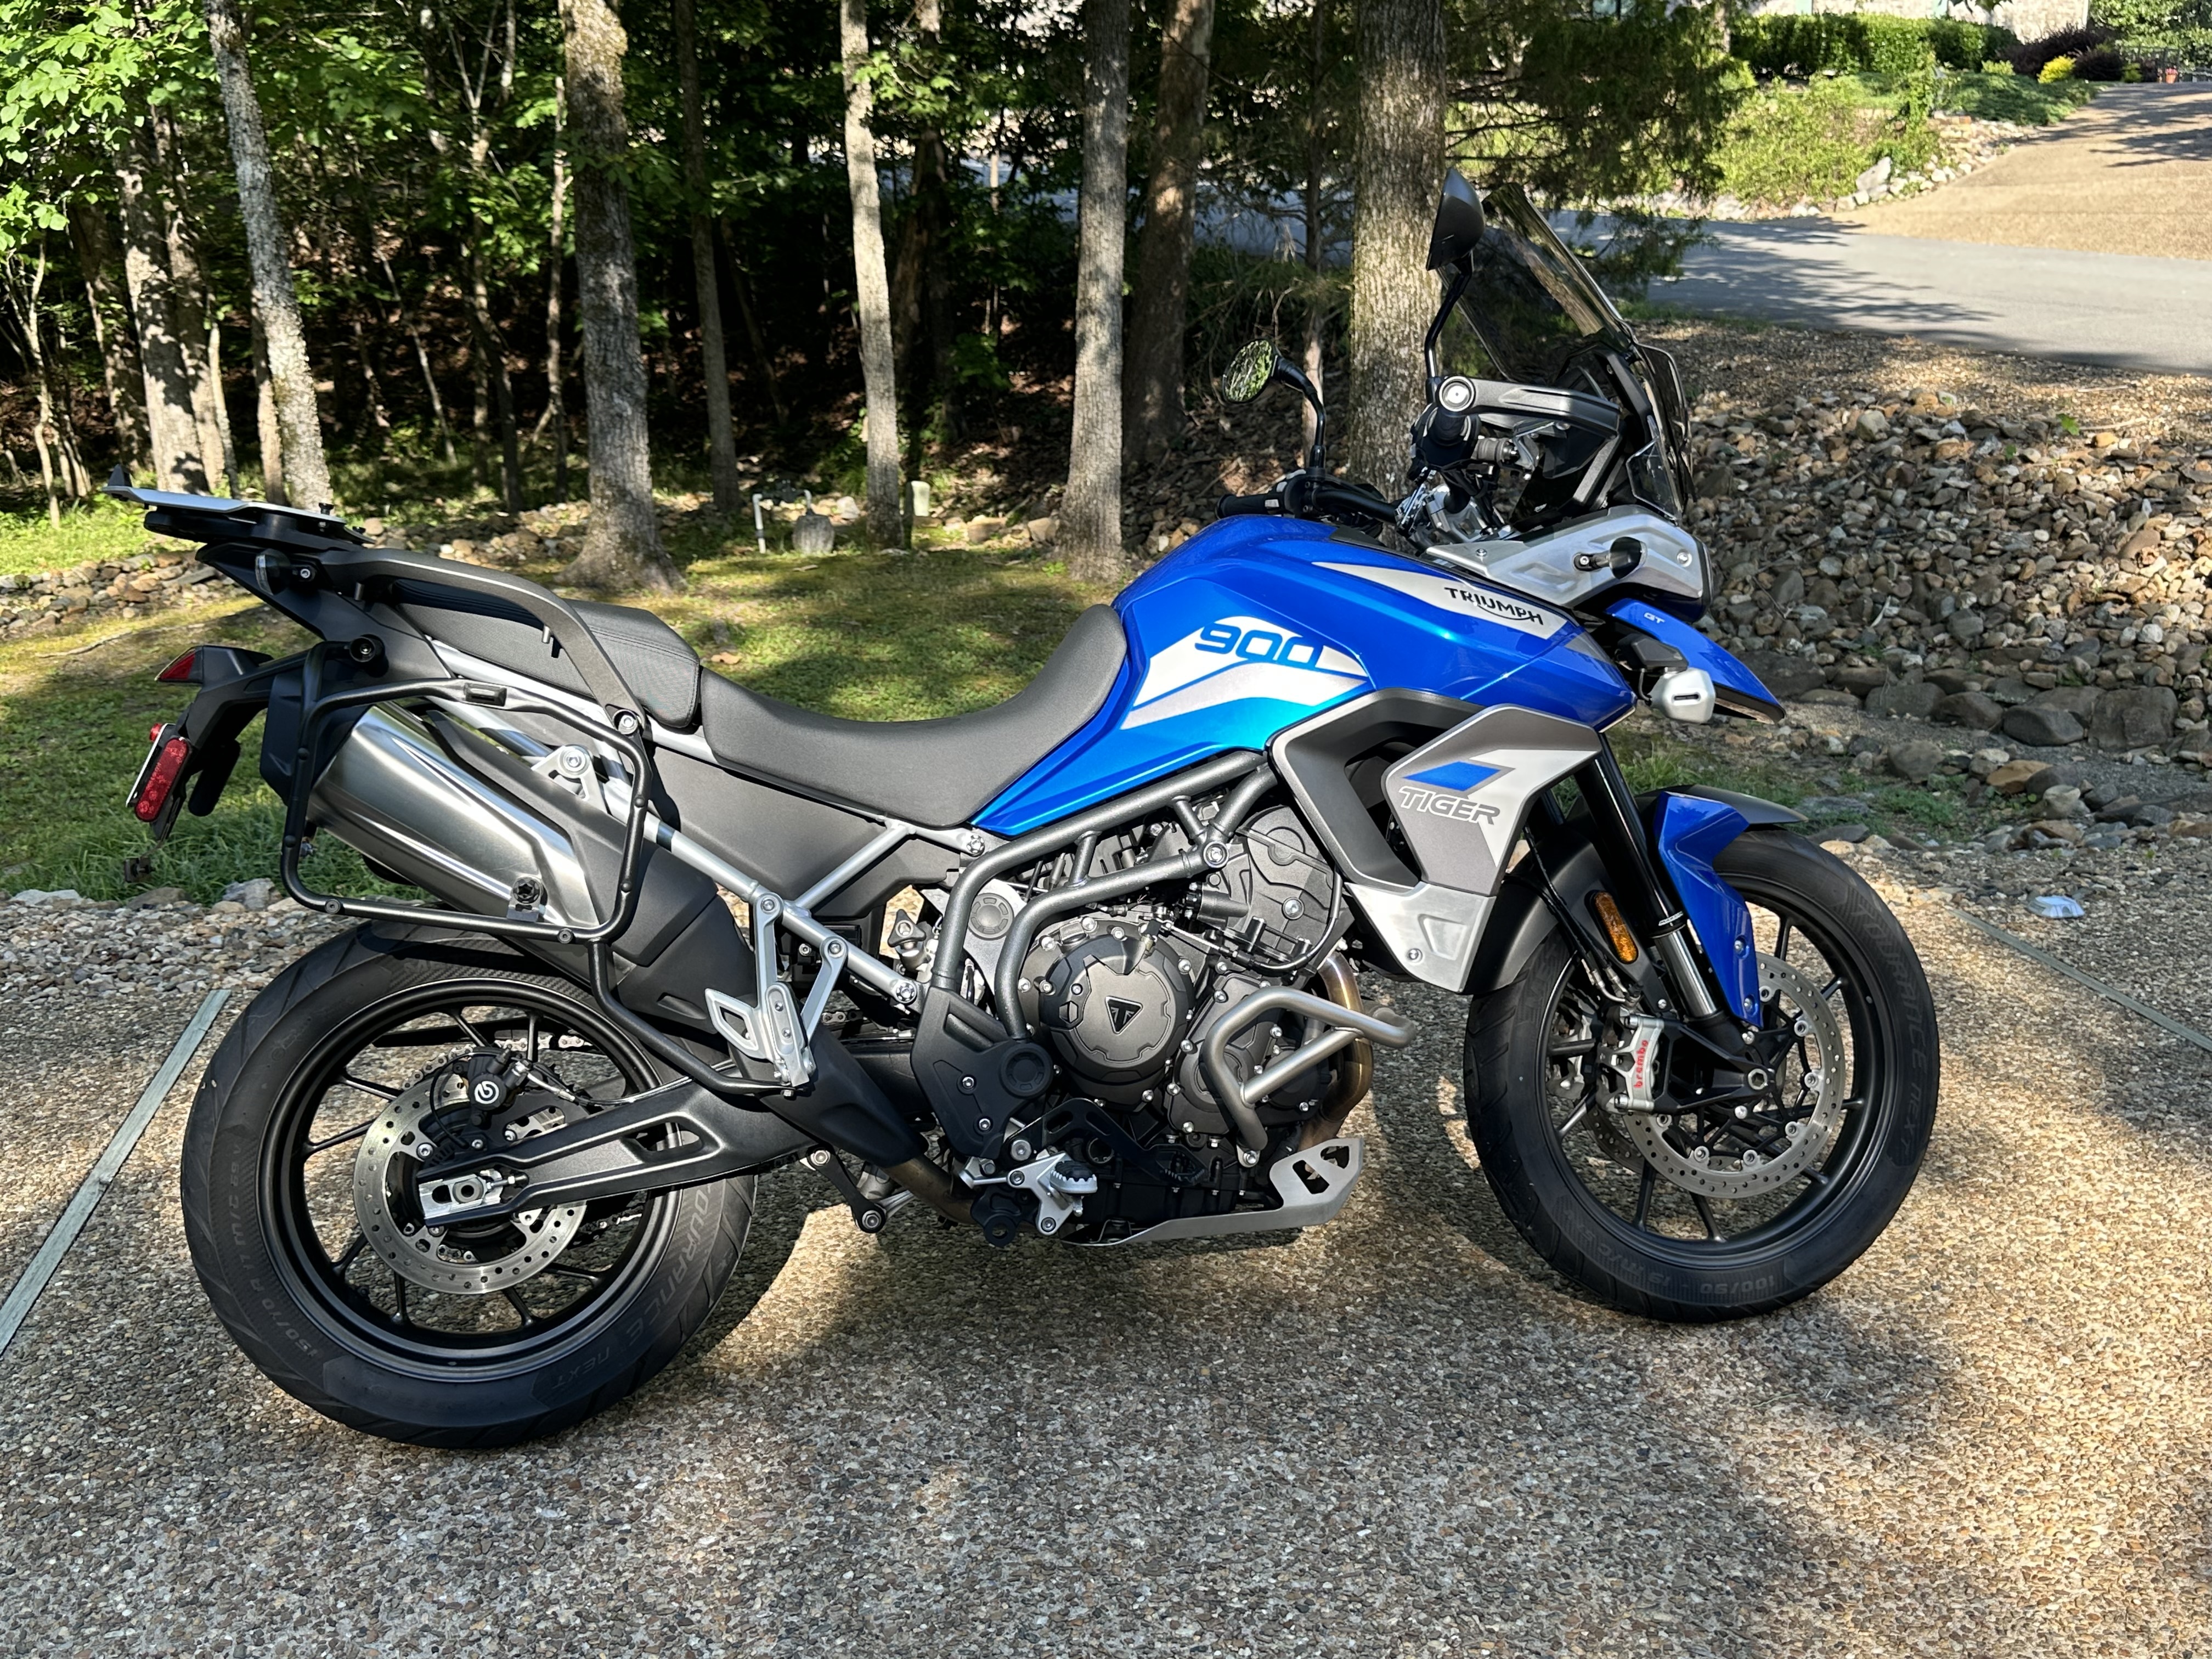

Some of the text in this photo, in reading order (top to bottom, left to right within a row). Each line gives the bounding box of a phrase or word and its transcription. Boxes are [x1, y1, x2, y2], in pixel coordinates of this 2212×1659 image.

[1444, 587, 1543, 625] TRIUMPH
[1644, 612, 1664, 624] GT
[1195, 623, 1324, 669] 900
[1398, 786, 1500, 825] TIGER
[1633, 1040, 1649, 1089] brembo
[626, 1184, 712, 1346] OURANCE
